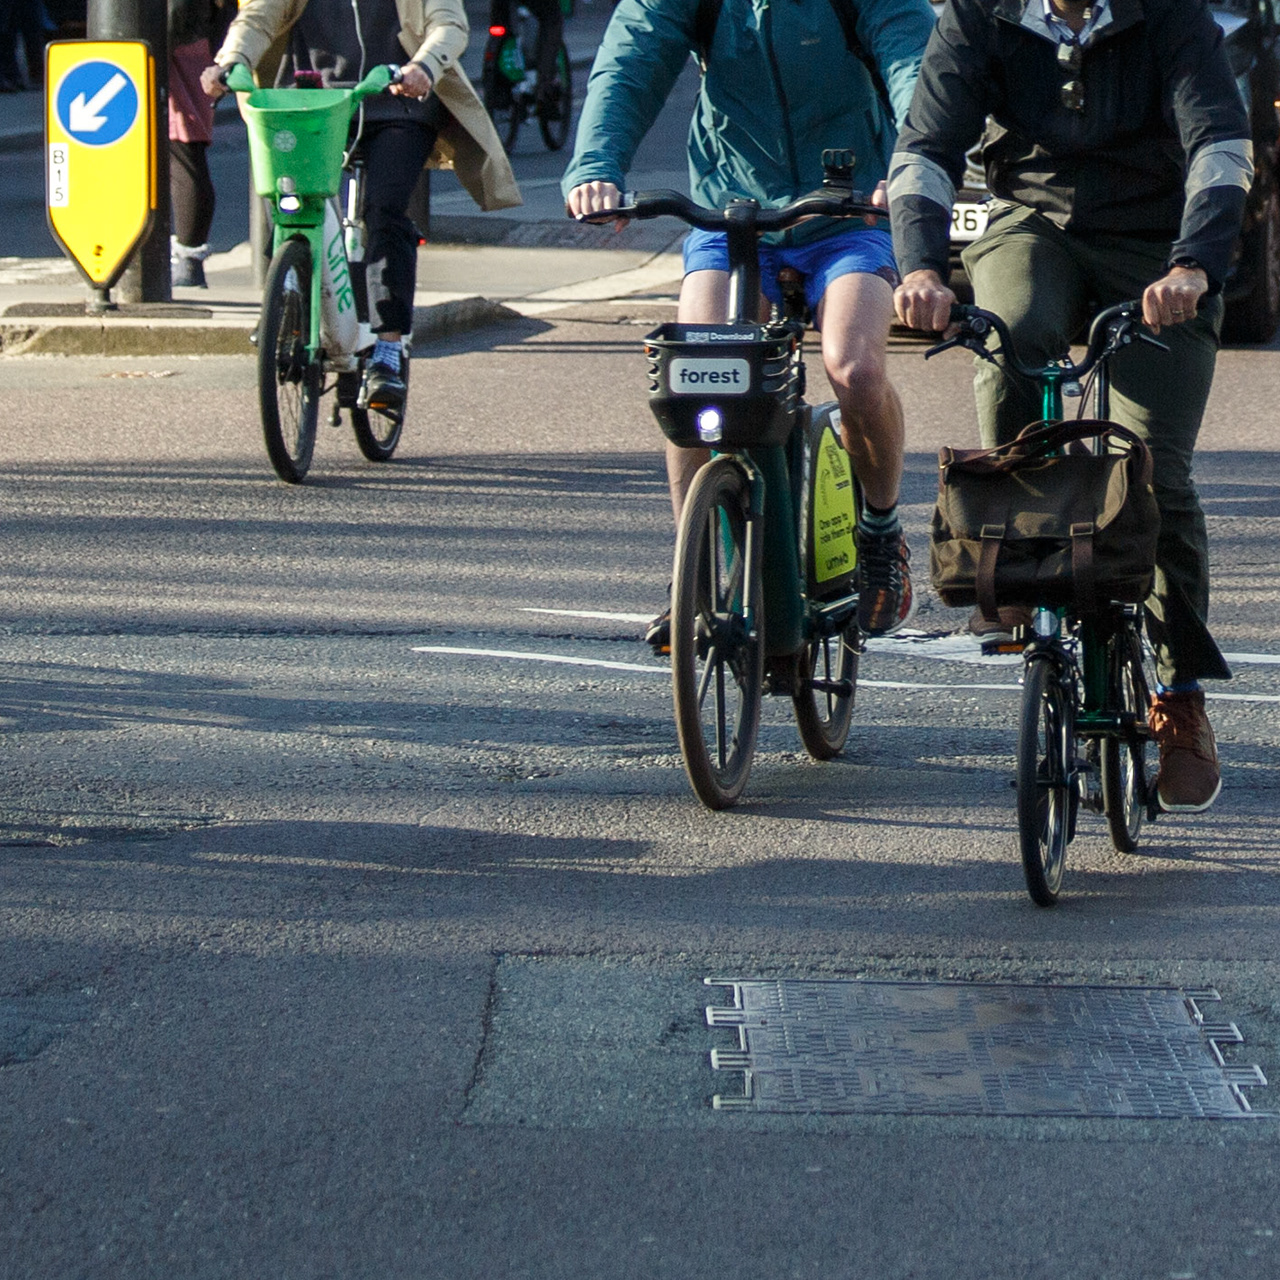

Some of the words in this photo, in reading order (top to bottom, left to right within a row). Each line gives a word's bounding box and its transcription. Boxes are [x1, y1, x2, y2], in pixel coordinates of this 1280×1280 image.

[327, 231, 352, 313] Lime
[710, 332, 755, 341] Download
[679, 368, 740, 384] forest
